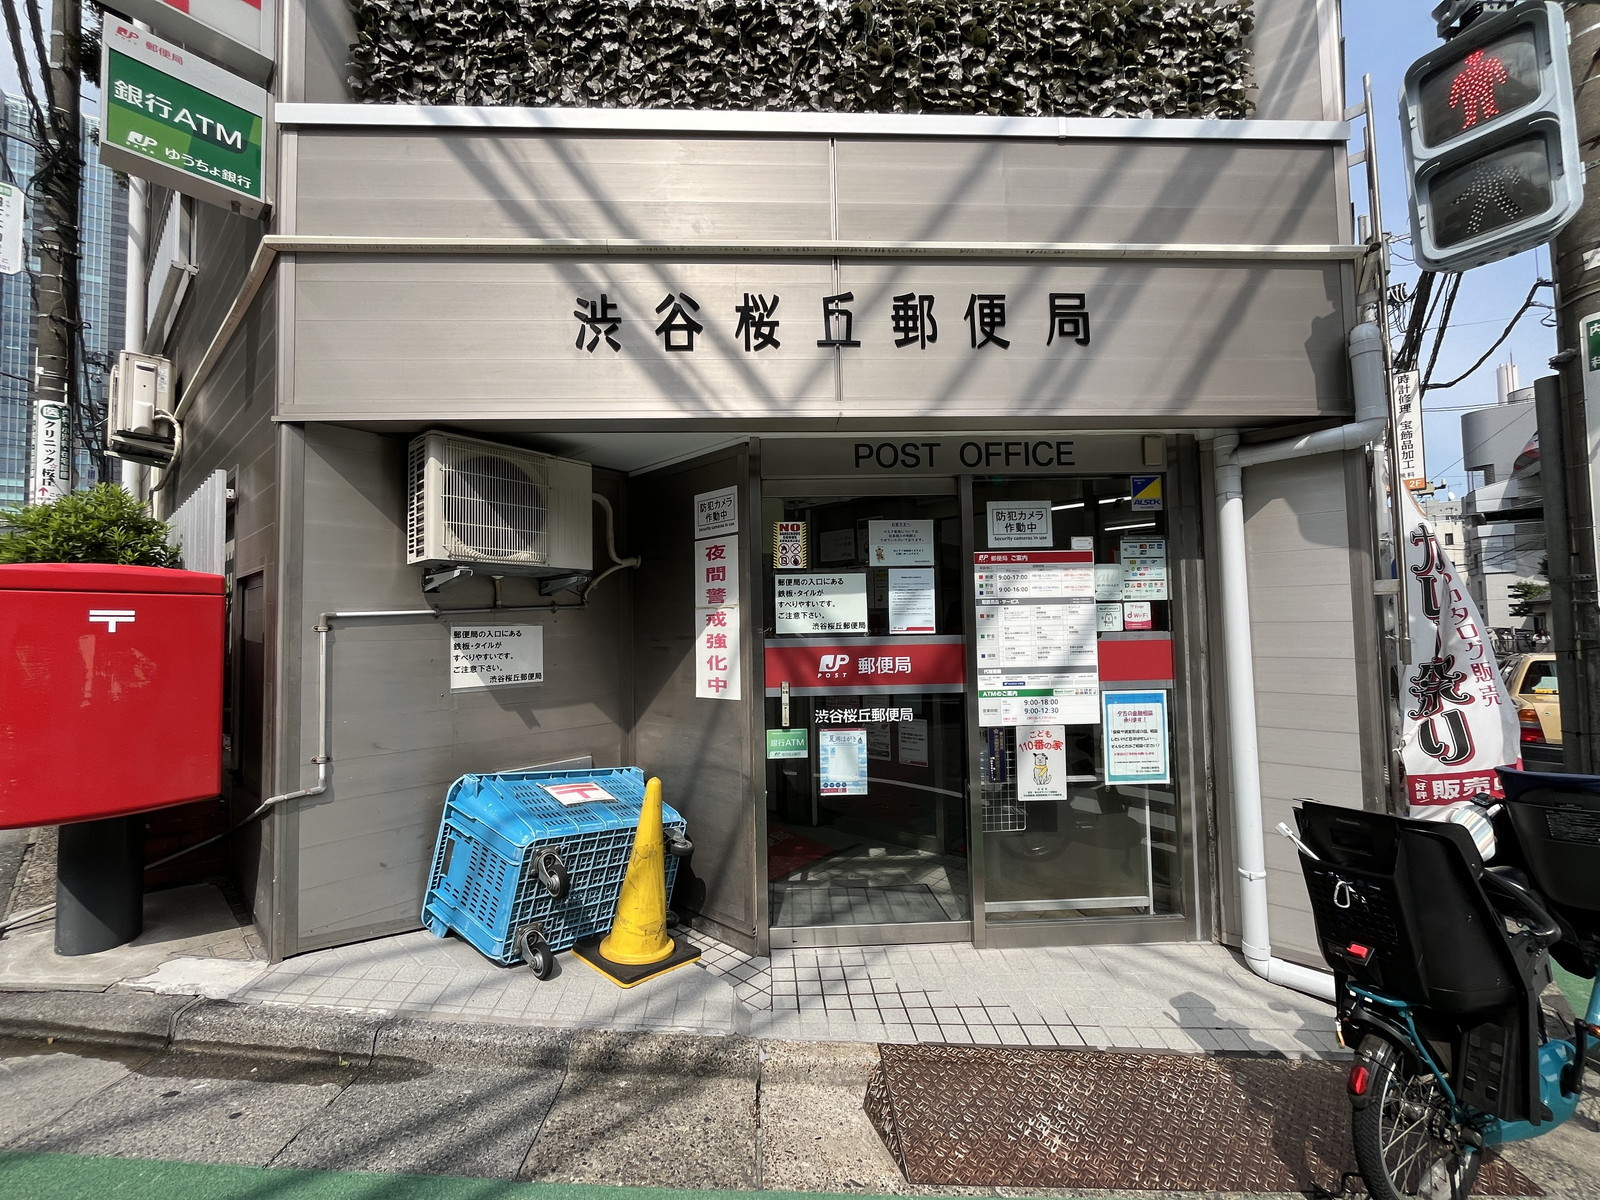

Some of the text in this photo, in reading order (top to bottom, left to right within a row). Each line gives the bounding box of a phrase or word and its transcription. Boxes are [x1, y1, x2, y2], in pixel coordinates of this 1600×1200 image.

[145, 41, 183, 65] 郵便局
[114, 80, 242, 149] 銀行ATM
[165, 147, 252, 189] ゆうちょ銀行
[573, 291, 1092, 352] 渋谷桜丘郵便局
[1400, 420, 1415, 470] 宝飾品加工
[854, 440, 1076, 468] POST OFFICE
[1409, 480, 1422, 488] 2F
[700, 497, 733, 513] 防犯カメラ
[705, 509, 728, 523] 作動中
[995, 510, 1044, 521] 防犯カメラ
[779, 524, 801, 532] NO
[1004, 522, 1037, 533] 作動中
[777, 578, 844, 587] 郵便局の入口にある
[777, 600, 836, 608] すべりやすいです。
[705, 544, 728, 693] 夜間警戒強化中
[778, 611, 825, 620] ご注意下さい。
[812, 621, 866, 631] 渋谷桜丘郵便局
[453, 630, 523, 639] 郵便局の入口にある
[453, 652, 514, 662] すべりやすいです。
[453, 664, 503, 674] ご注意下さい。
[858, 656, 912, 674] 郵便局
[489, 672, 542, 683] 渋谷桜丘郵便局
[815, 707, 914, 723] 渋谷桜丘郵便局
[1024, 707, 1059, 715] 9:00-12:30
[1029, 730, 1053, 739] こども
[770, 738, 805, 747] 銀行ATM
[1019, 739, 1064, 752] 110番の家
[1415, 782, 1428, 800] 好評
